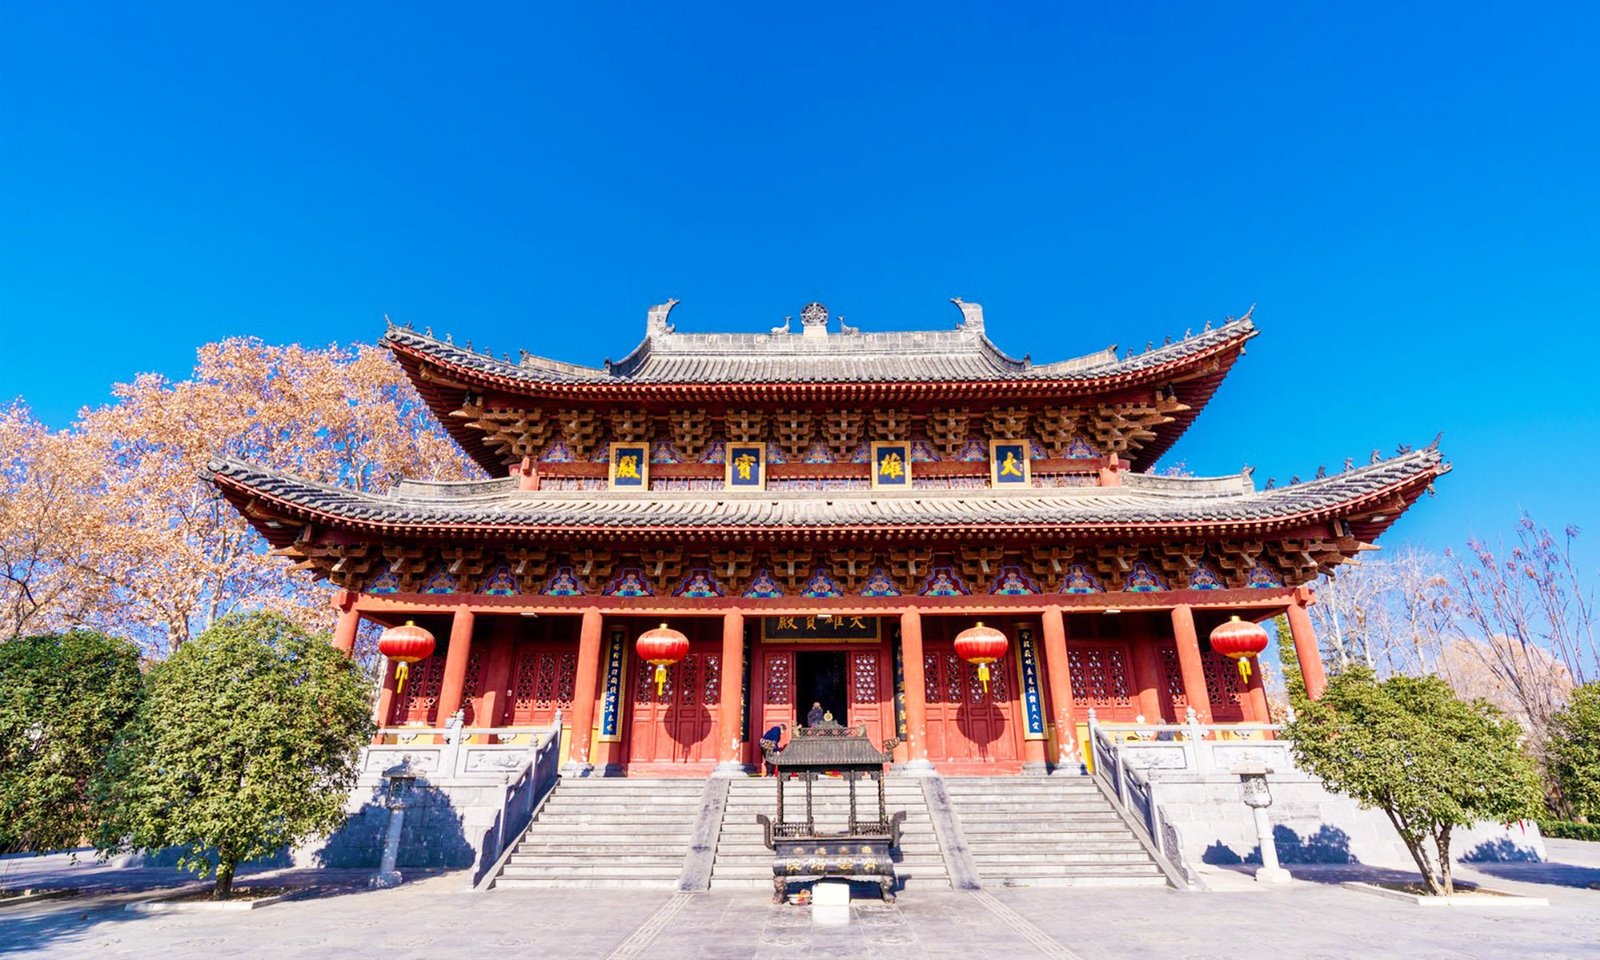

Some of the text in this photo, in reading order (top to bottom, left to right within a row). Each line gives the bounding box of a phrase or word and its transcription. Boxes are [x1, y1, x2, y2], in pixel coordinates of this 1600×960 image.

[616, 455, 641, 478] 殿
[734, 453, 757, 480] 寶
[879, 452, 904, 479] 雄
[1000, 451, 1022, 477] 大
